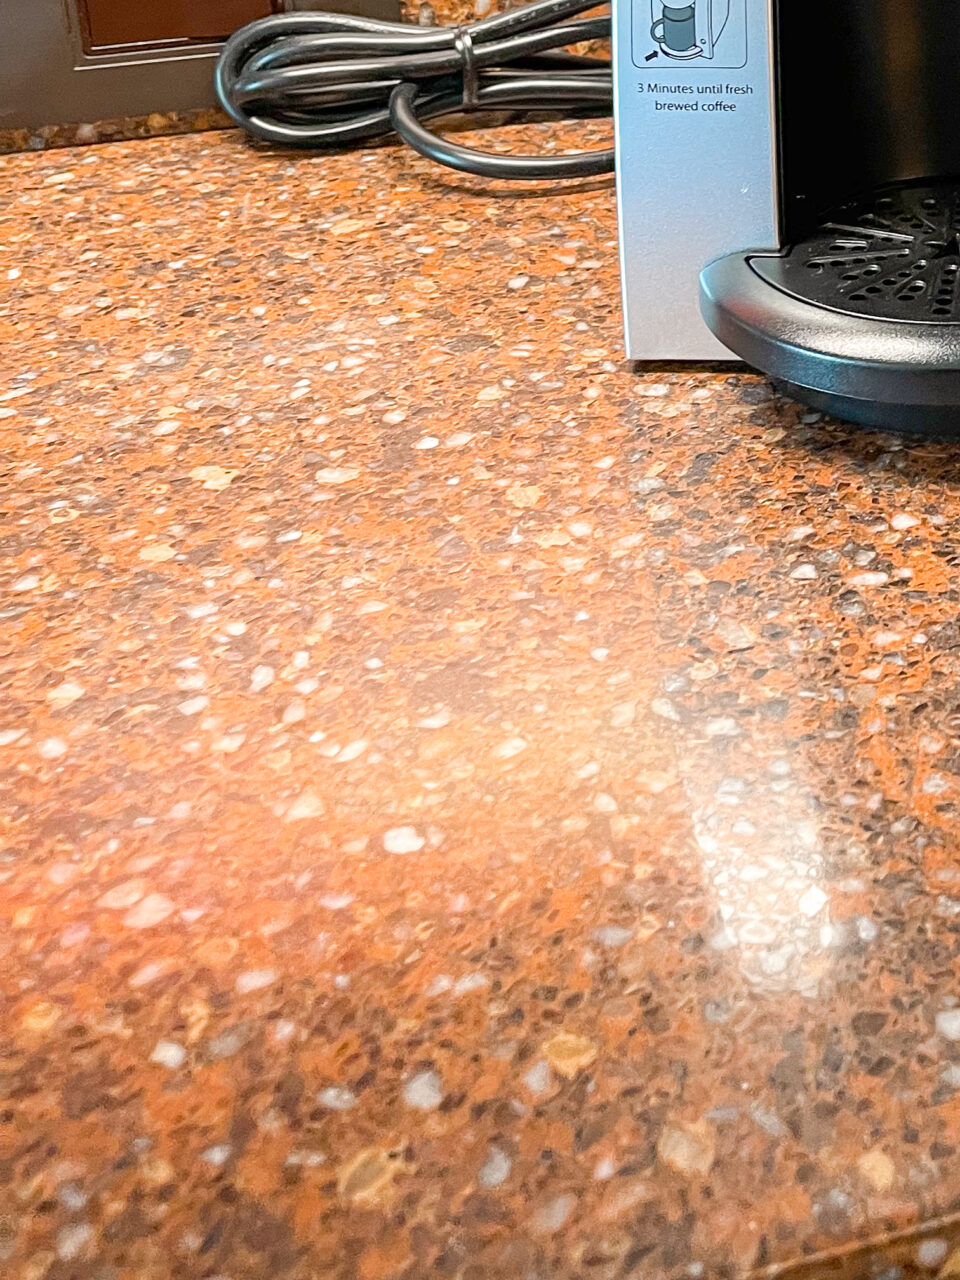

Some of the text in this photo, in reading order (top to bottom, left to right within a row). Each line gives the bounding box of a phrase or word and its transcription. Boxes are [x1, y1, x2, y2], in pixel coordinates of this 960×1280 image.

[637, 82, 754, 95] 3 Minutes until fresh
[655, 100, 737, 112] brewed coffee
